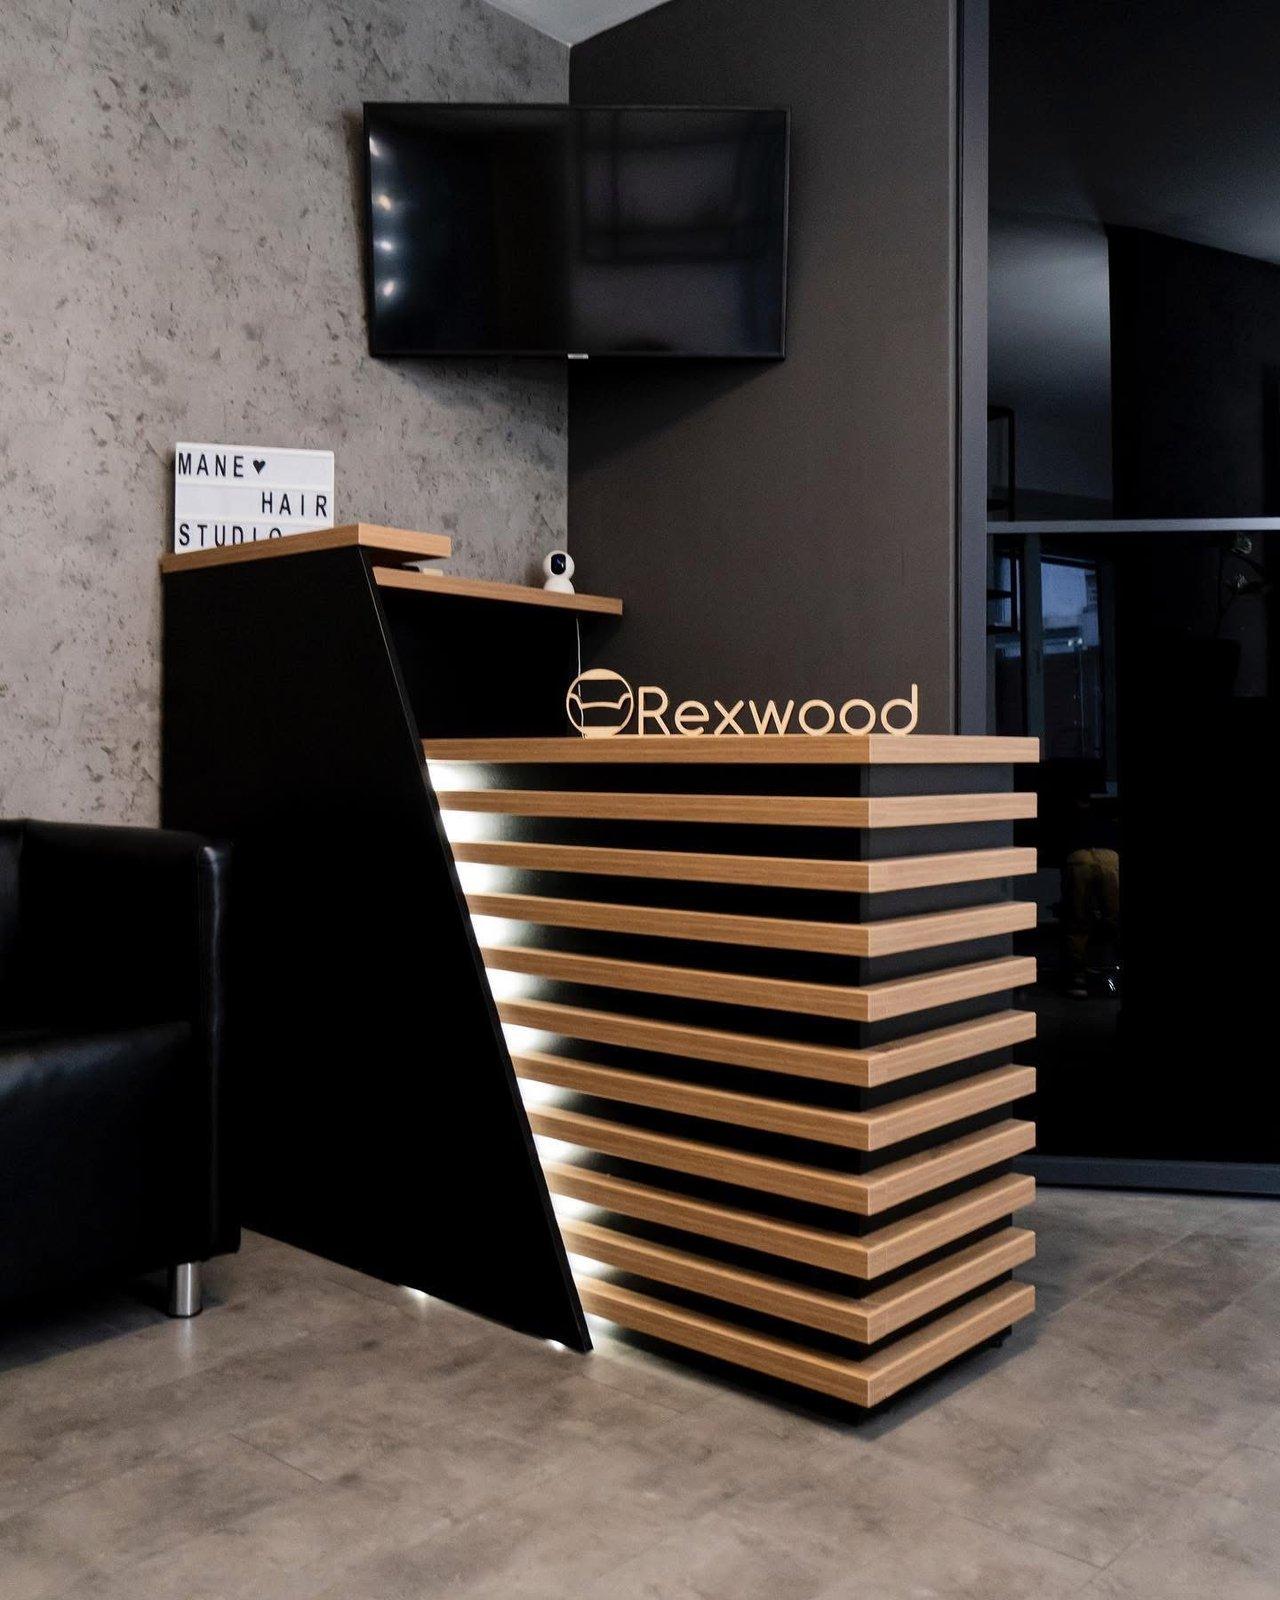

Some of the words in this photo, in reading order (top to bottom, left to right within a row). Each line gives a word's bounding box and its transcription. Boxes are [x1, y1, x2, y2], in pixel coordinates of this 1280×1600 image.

[178, 453, 244, 478] MANE
[261, 491, 327, 517] HAIR
[638, 683, 918, 736] Rexwood
